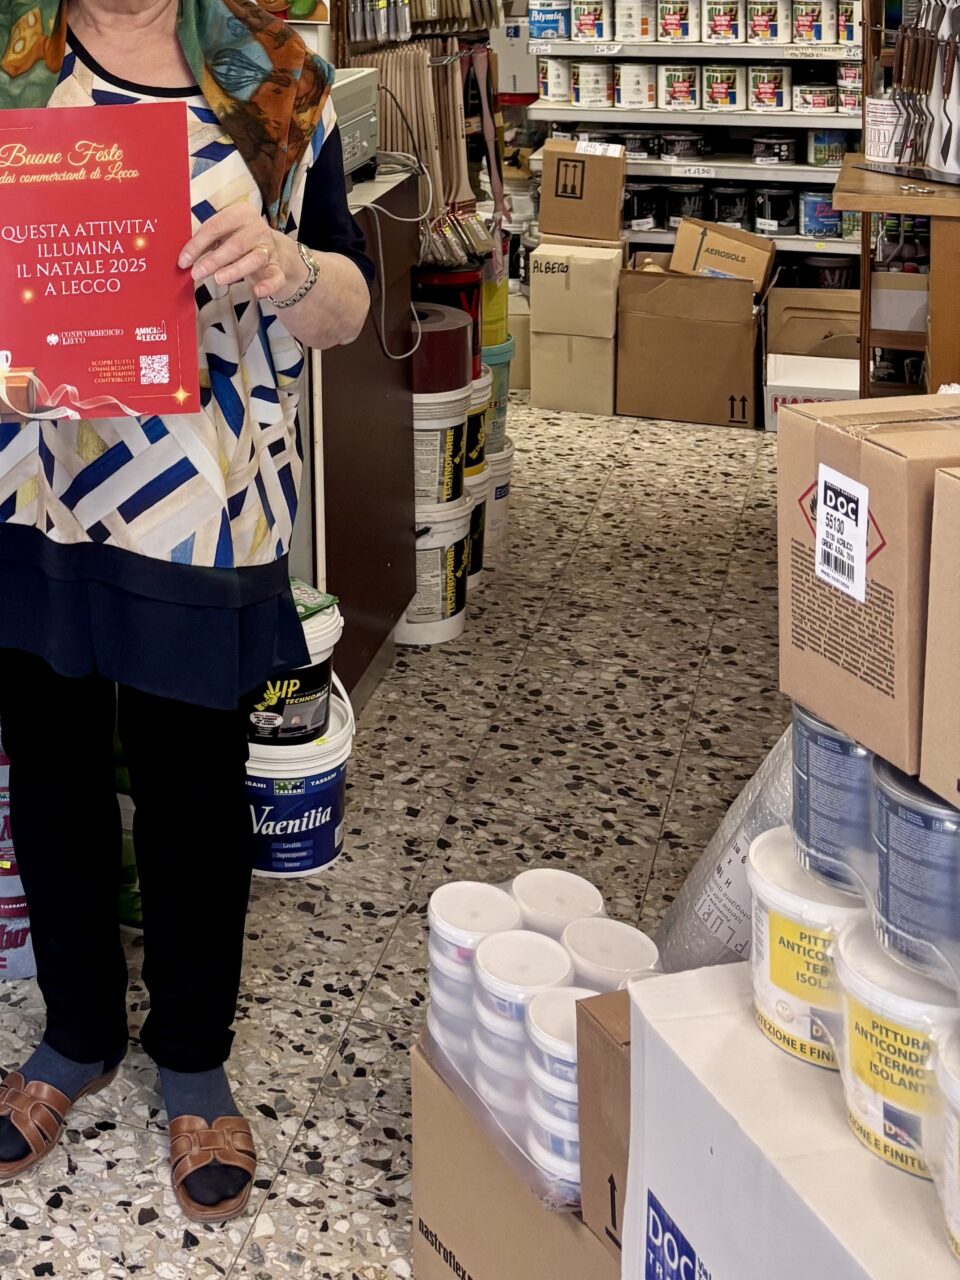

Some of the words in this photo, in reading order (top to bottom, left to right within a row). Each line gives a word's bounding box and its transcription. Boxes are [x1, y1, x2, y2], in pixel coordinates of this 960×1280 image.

[68, 140, 123, 167] Feste
[19, 169, 87, 184] commercianti
[90, 167, 101, 180] di
[105, 162, 139, 182] Lecco
[1, 223, 71, 244] QUESTA
[74, 219, 158, 239] ATTIVITA'
[37, 240, 124, 258] ILLUMINA
[704, 246, 746, 264] AEROSOLS
[17, 264, 32, 279] IL
[35, 259, 106, 277] NATALE
[109, 257, 147, 274] 2025
[533, 260, 569, 274] ALBERO
[44, 281, 57, 296] A
[61, 278, 121, 295] LECCO
[61, 328, 124, 338] CONFCOMMERCIO
[62, 336, 86, 346] LECCO
[135, 327, 157, 335] AMICI
[142, 332, 167, 342] LECCO
[826, 490, 858, 520] DOC
[825, 511, 845, 536] 55130
[266, 679, 300, 702] VIP
[245, 781, 267, 789] SSANI
[311, 772, 337, 787] TASSANI
[249, 803, 332, 836] Vaenilia
[800, 931, 831, 948] PITT
[804, 960, 830, 977] TER
[854, 1021, 928, 1065] ANTICONDE
[871, 1020, 930, 1051] PITTURA
[800, 1043, 807, 1054] E
[874, 1139, 882, 1151] E
[884, 1144, 928, 1171] FINITU
[648, 1206, 694, 1280] DOC
